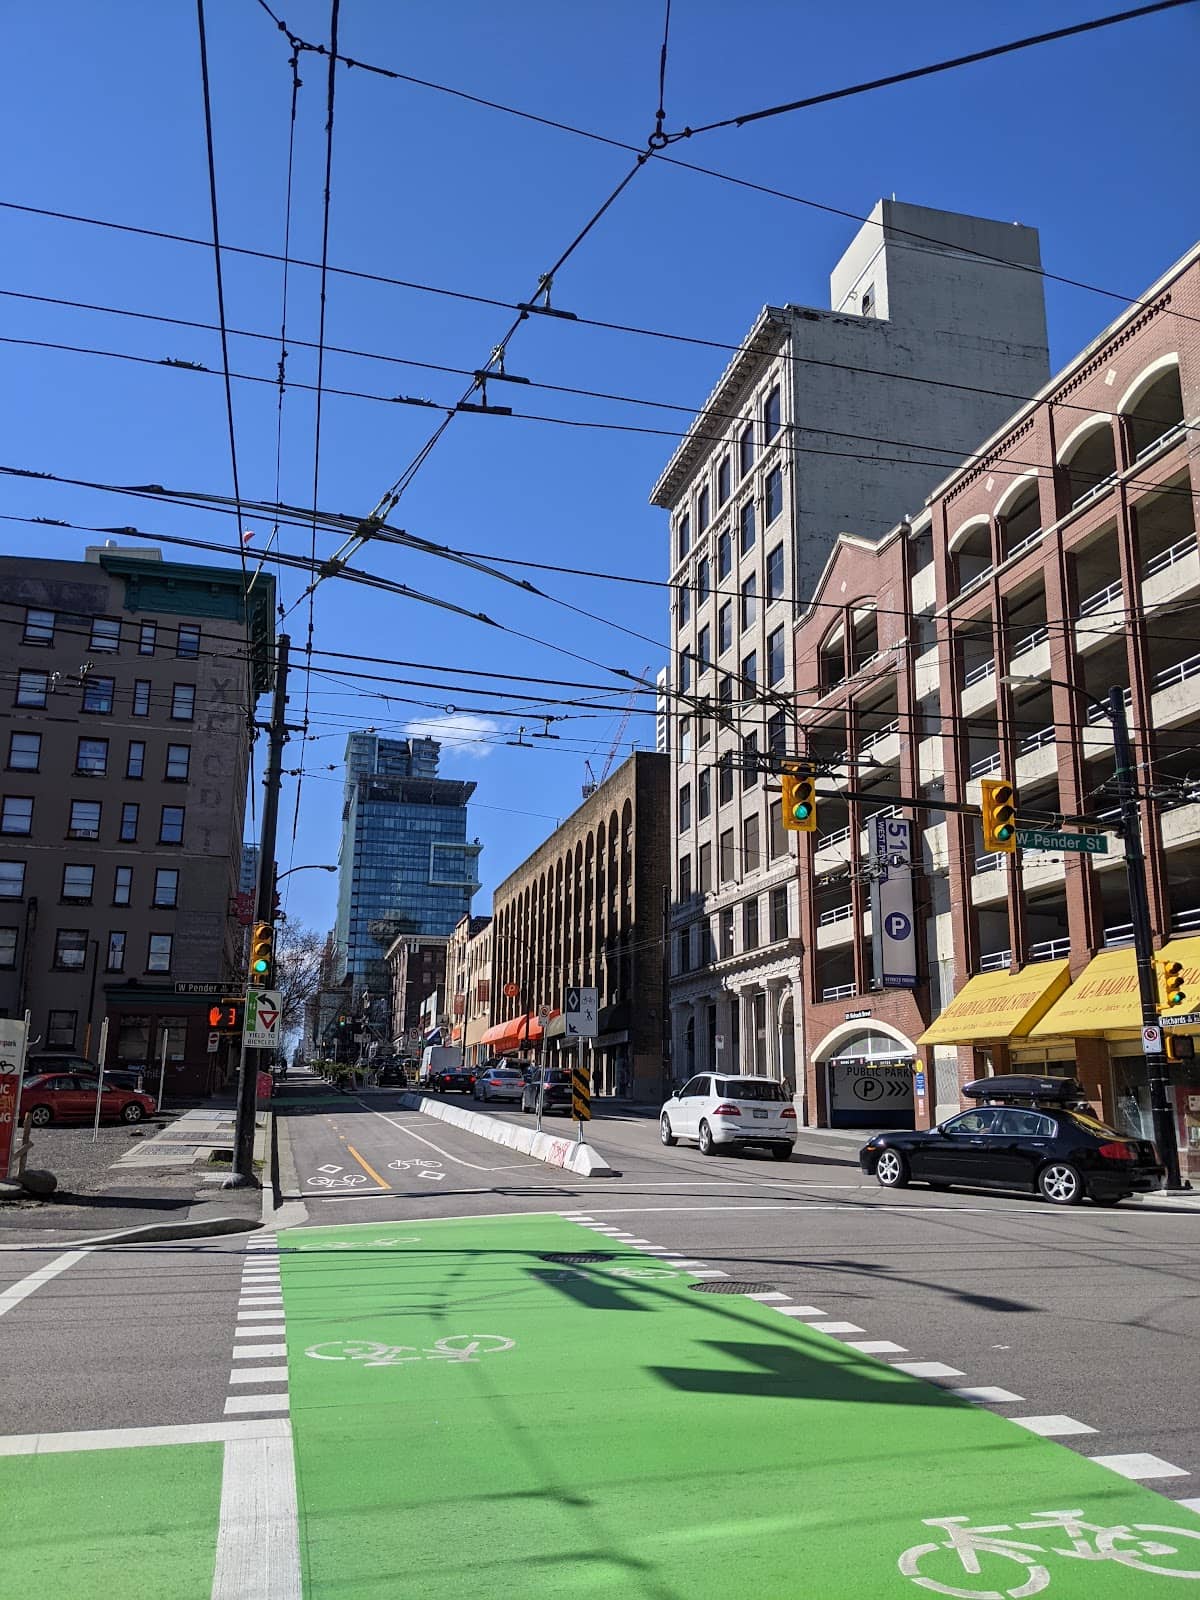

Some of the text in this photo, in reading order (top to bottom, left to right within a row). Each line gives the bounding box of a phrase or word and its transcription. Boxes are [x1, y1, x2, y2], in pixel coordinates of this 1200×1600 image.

[1016, 832, 1101, 850] W Pender St
[891, 917, 905, 935] P
[188, 983, 217, 993] Pender
[228, 1008, 236, 1025] 3
[847, 1066, 912, 1078] PUBLIC PARK
[863, 1080, 875, 1097] P
